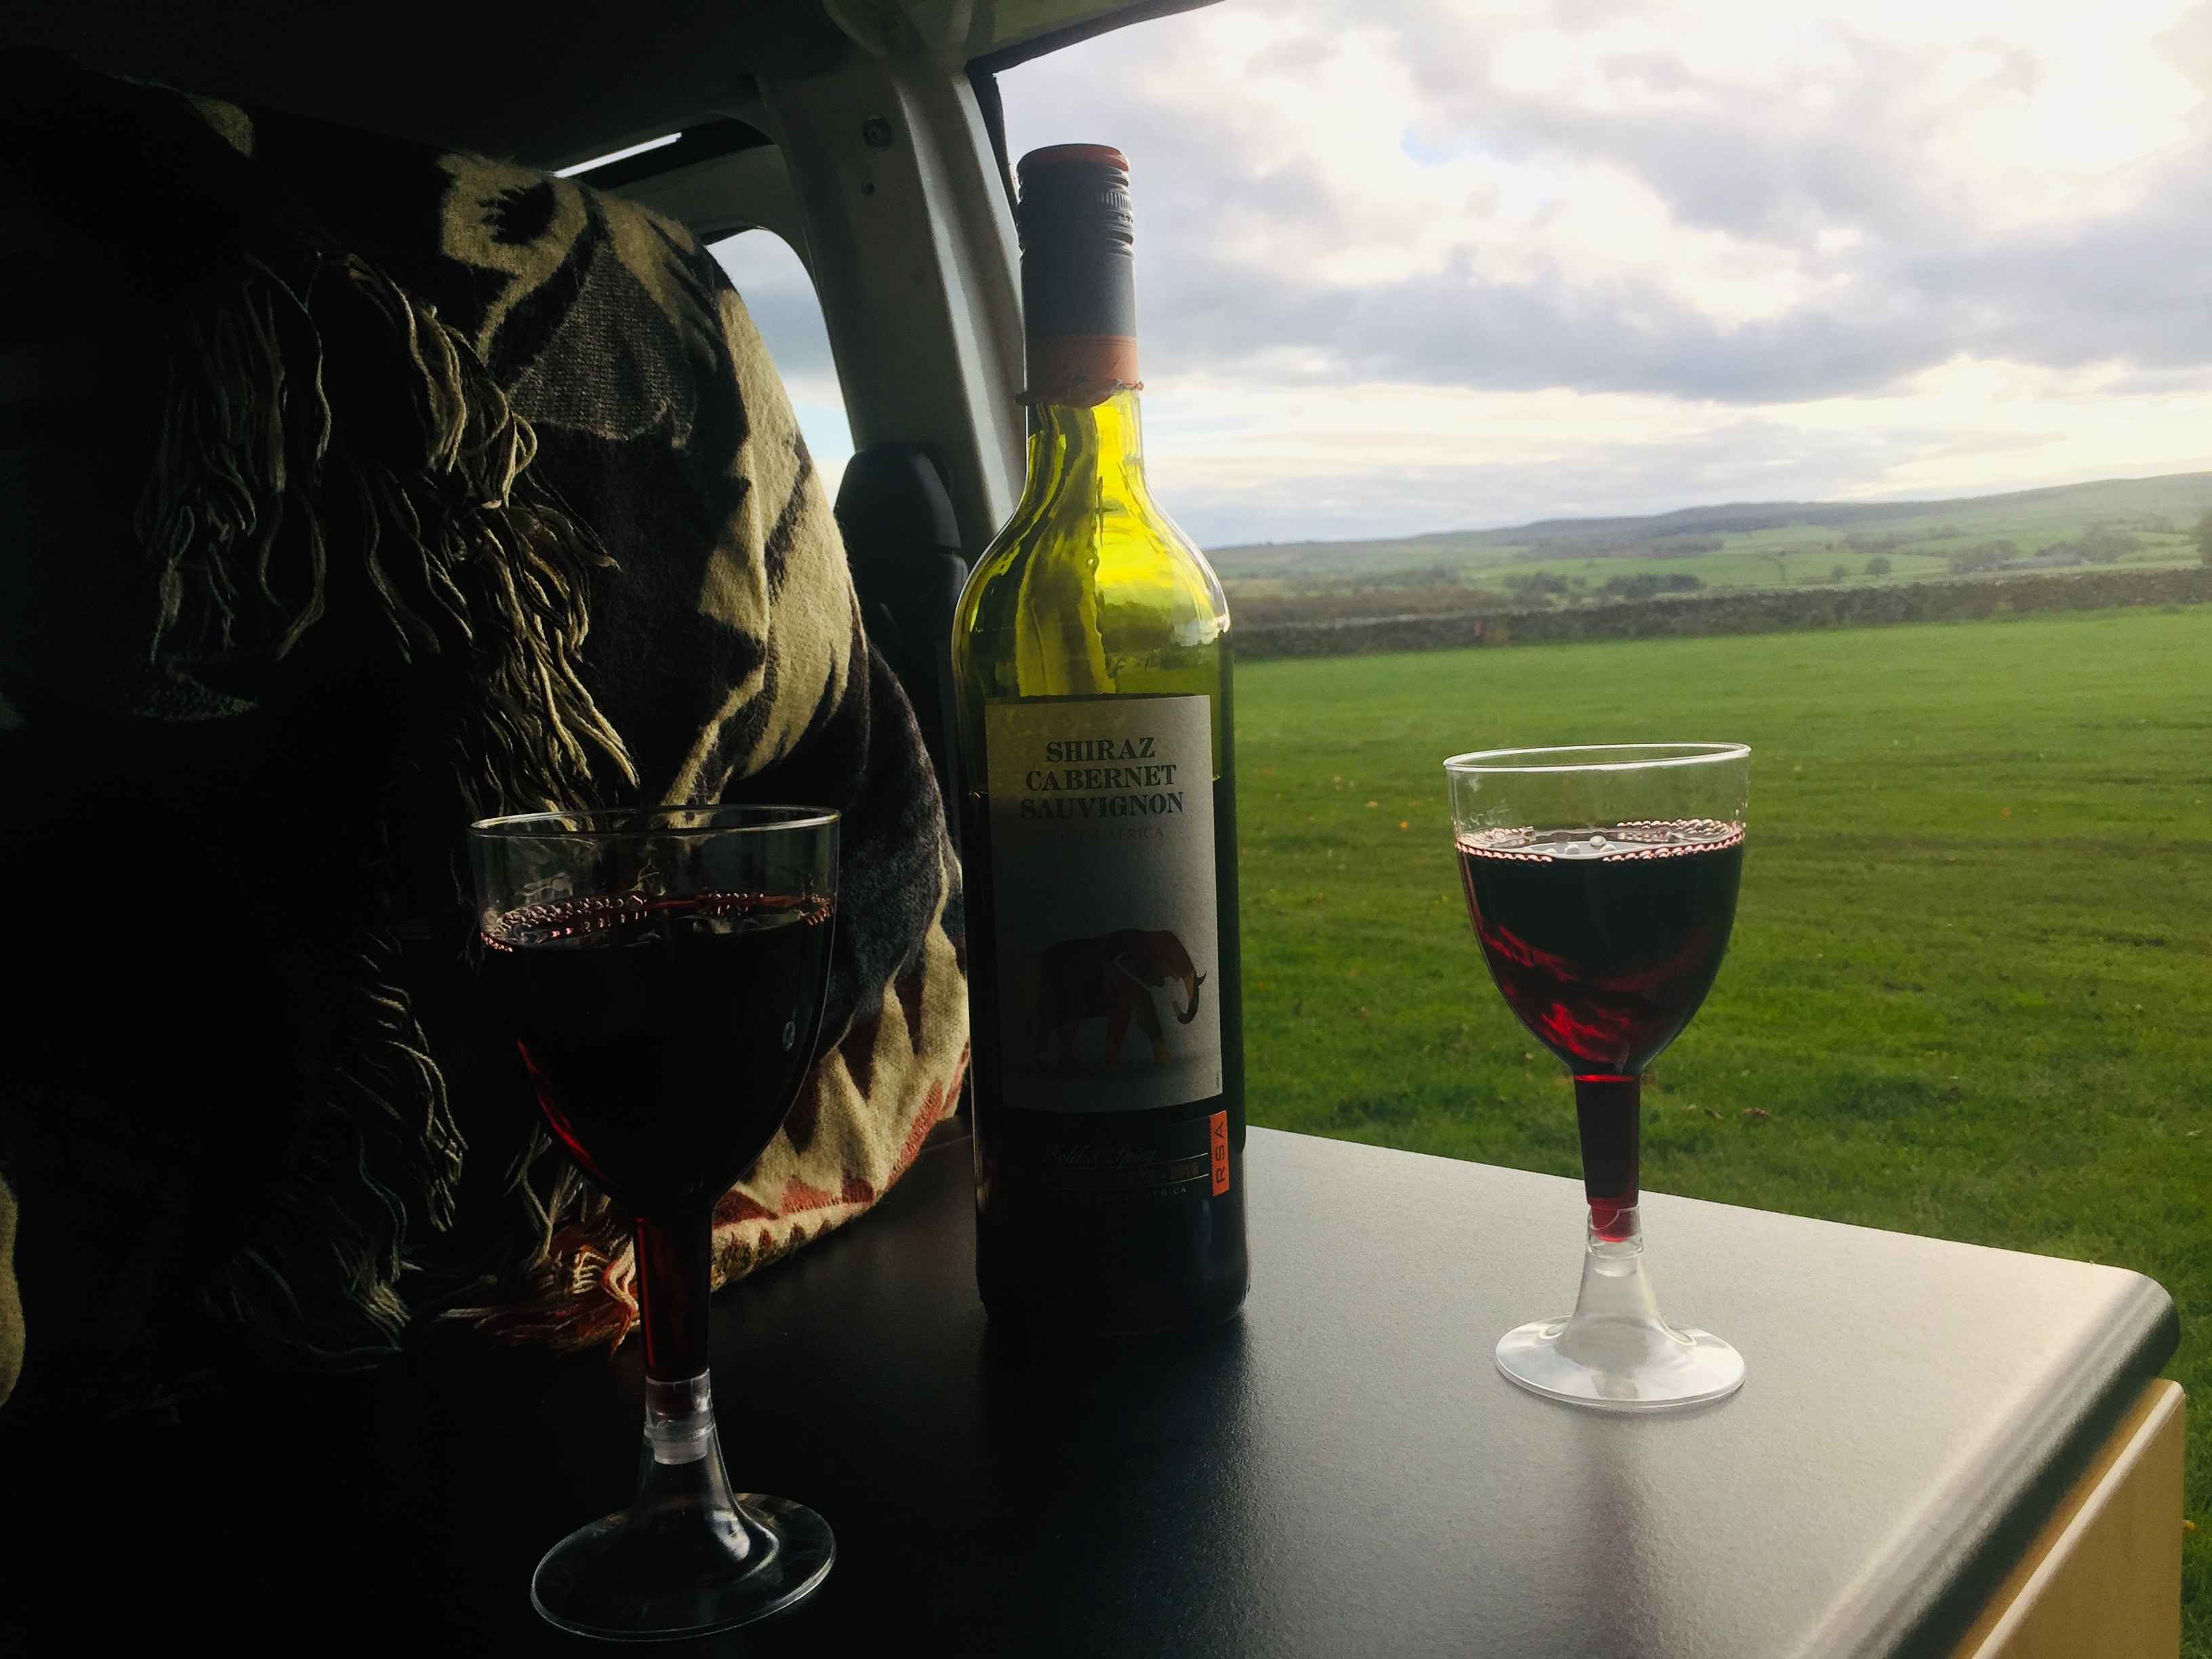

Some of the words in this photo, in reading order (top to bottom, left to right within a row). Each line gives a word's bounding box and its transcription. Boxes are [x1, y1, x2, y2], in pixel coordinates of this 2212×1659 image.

[1046, 737, 1155, 762] SHIRAZ
[1026, 764, 1176, 791] CABERNET
[1021, 792, 1184, 819] SAUVIGNON
[1214, 1122, 1225, 1183] RSA
